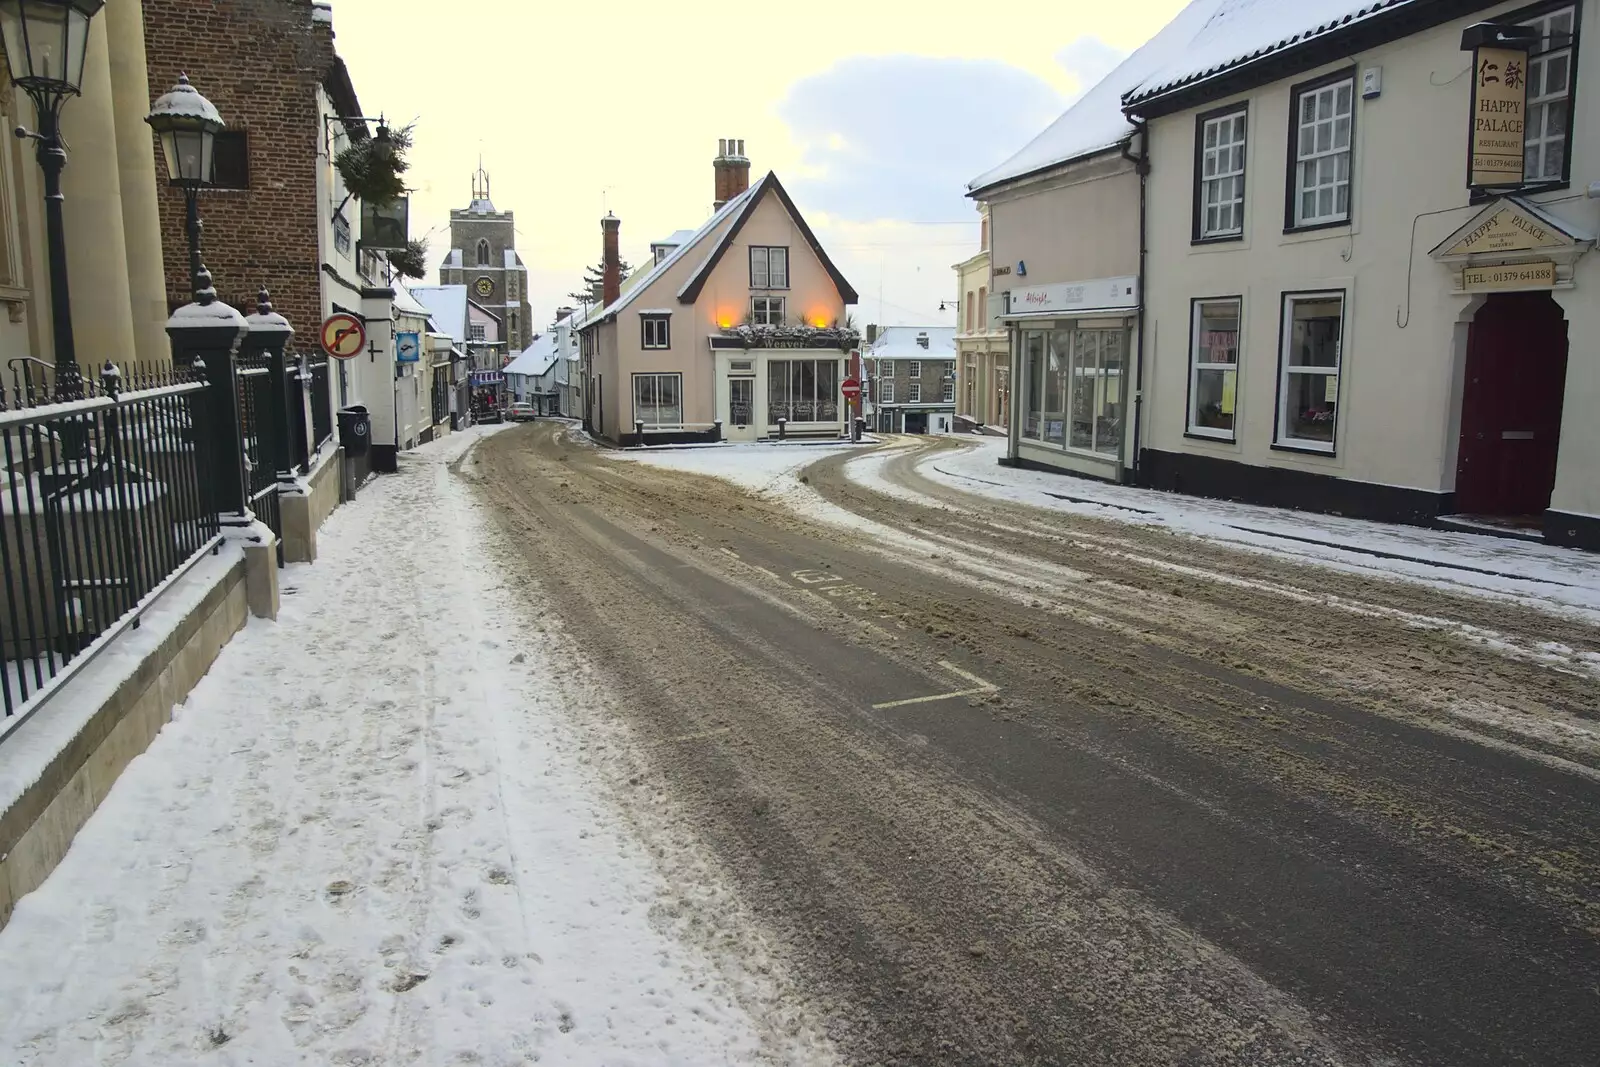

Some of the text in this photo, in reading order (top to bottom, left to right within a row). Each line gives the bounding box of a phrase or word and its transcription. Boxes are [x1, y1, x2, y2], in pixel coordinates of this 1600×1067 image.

[1480, 99, 1521, 114] HAPPY
[1476, 118, 1523, 133] PALACE
[1479, 140, 1519, 149] RESTAURANT
[1464, 214, 1546, 247] HAPPY PALACE
[1493, 272, 1518, 282] 01379
[1519, 269, 1551, 280] 641888
